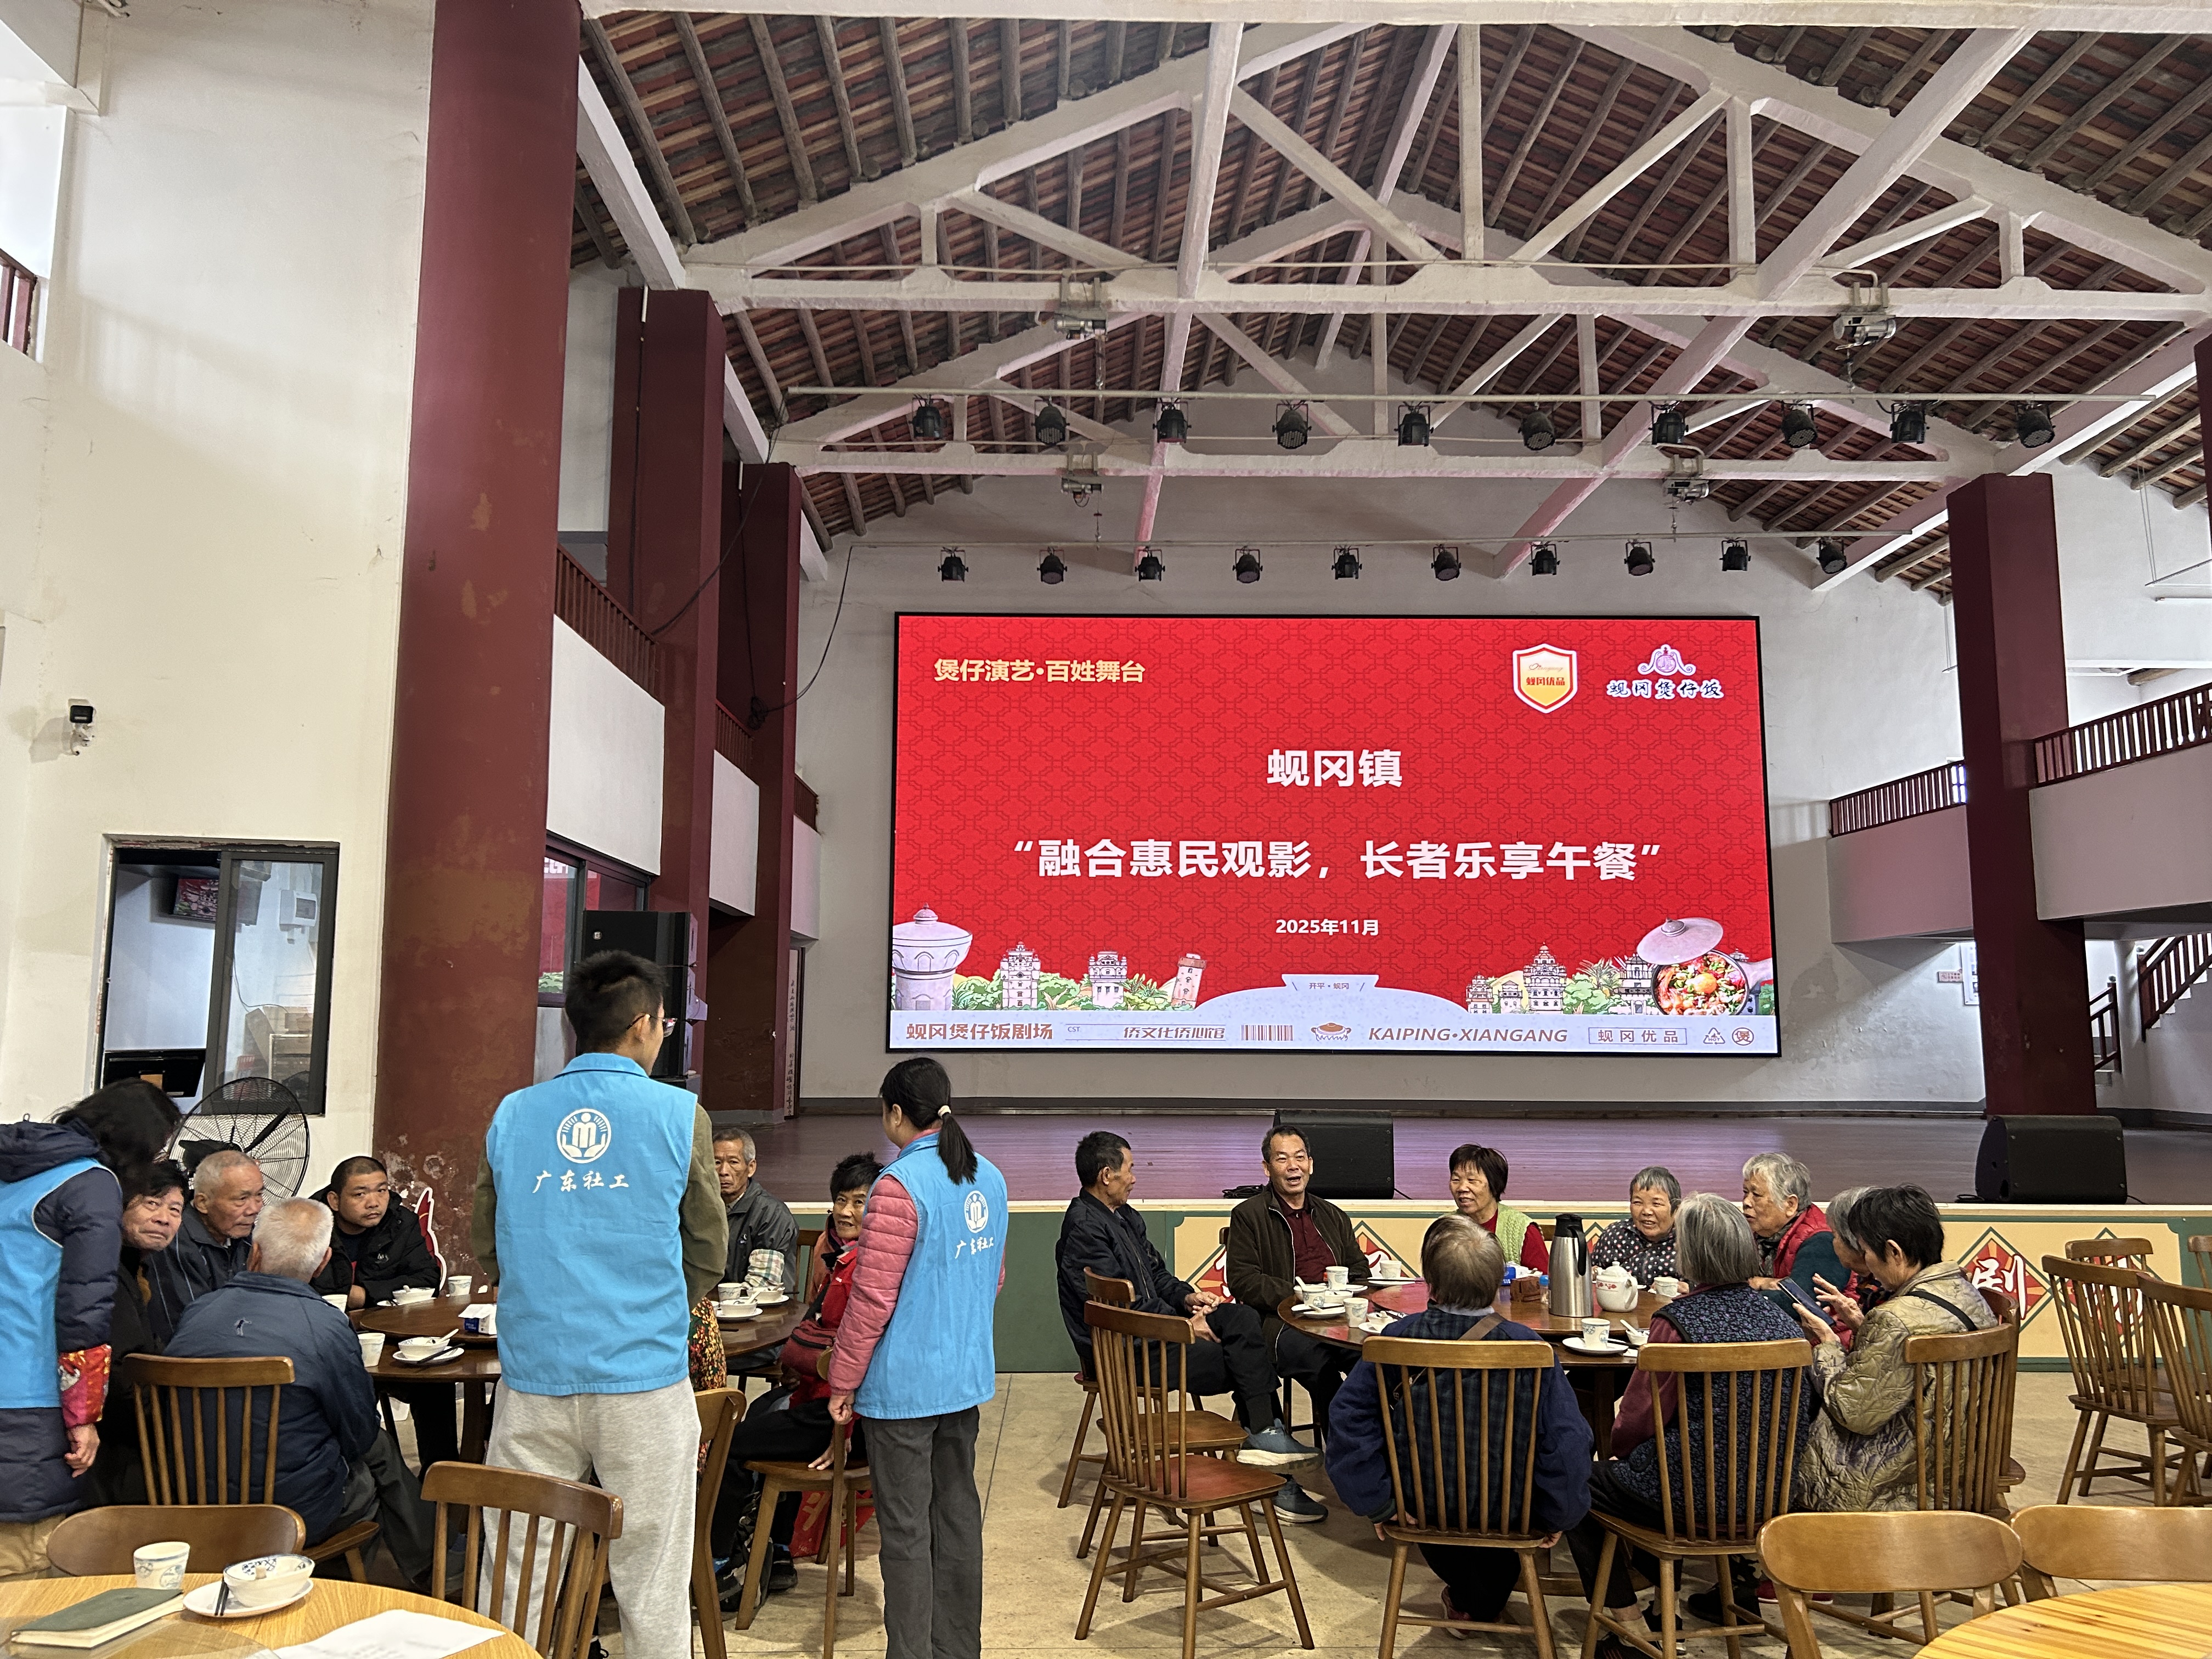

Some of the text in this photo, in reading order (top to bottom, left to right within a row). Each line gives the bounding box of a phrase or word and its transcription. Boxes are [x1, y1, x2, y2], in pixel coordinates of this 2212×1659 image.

[934, 658, 1146, 683] 煲仔演艺·百姓舞台
[1609, 680, 1721, 698] 蚬冈煲仔饭
[1266, 749, 1403, 788] 蚬冈镇
[1276, 919, 1379, 936] 2025年11月
[906, 1023, 1053, 1040] 蚬冈煲仔饭剧场
[1598, 1029, 1678, 1043] 蚬冈优品
[532, 1169, 630, 1194] 广东社工
[955, 1236, 995, 1259] 广东社工
